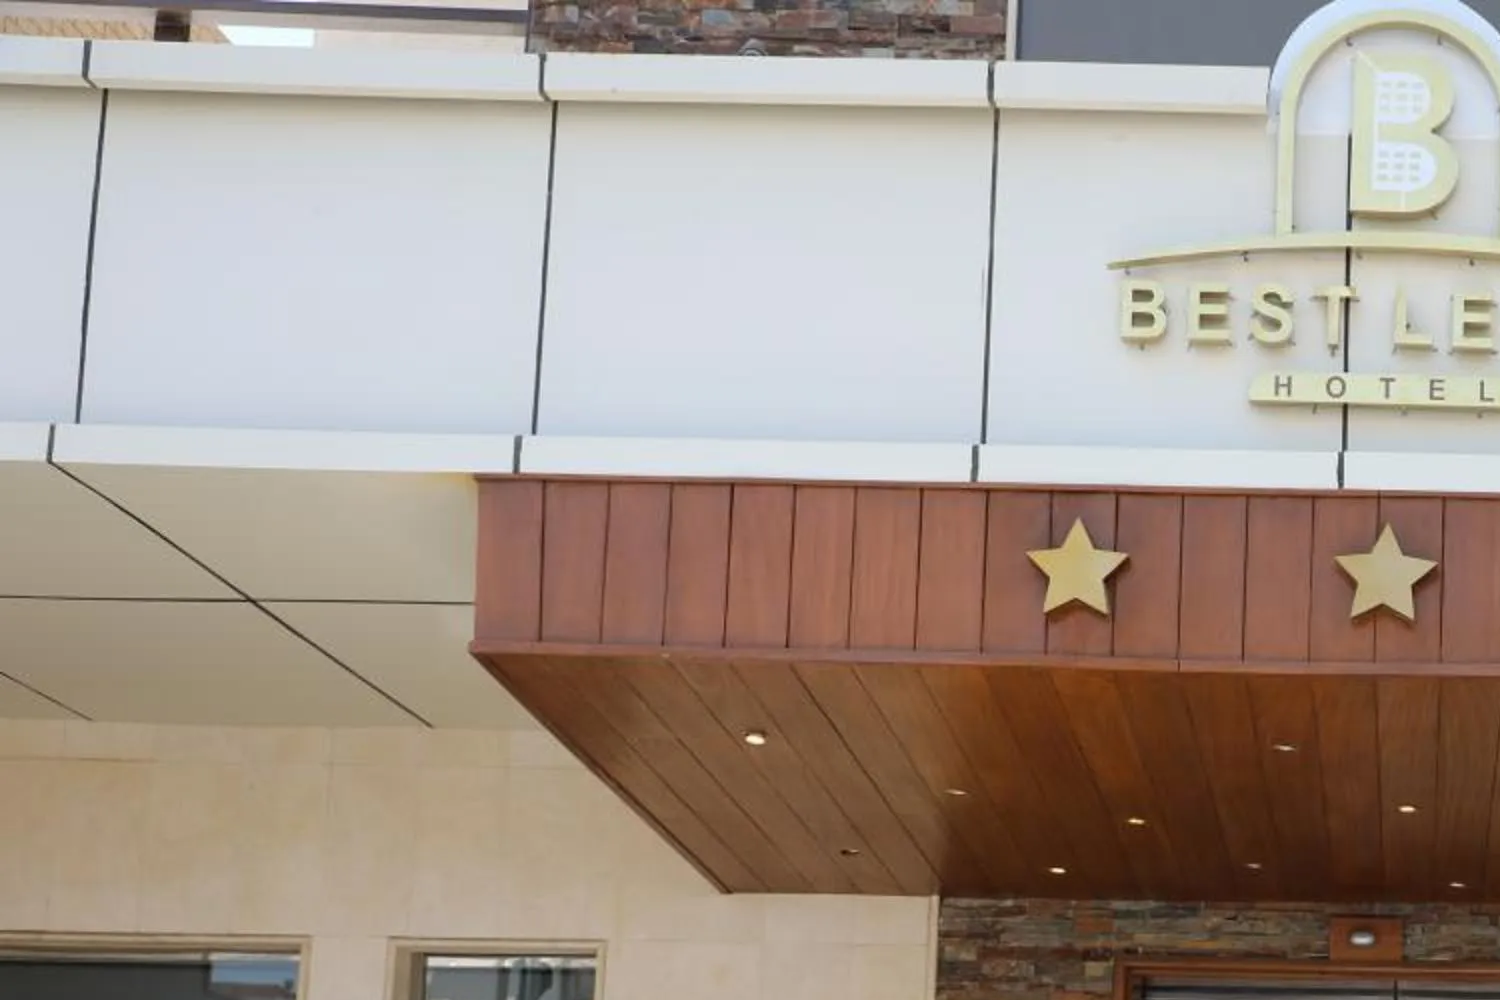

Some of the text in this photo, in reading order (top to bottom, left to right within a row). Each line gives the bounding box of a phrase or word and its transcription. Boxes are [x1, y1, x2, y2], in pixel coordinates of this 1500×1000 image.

[1350, 51, 1460, 216] B
[1120, 279, 1358, 347] BEST
[1273, 374, 1495, 402] HOTEL
